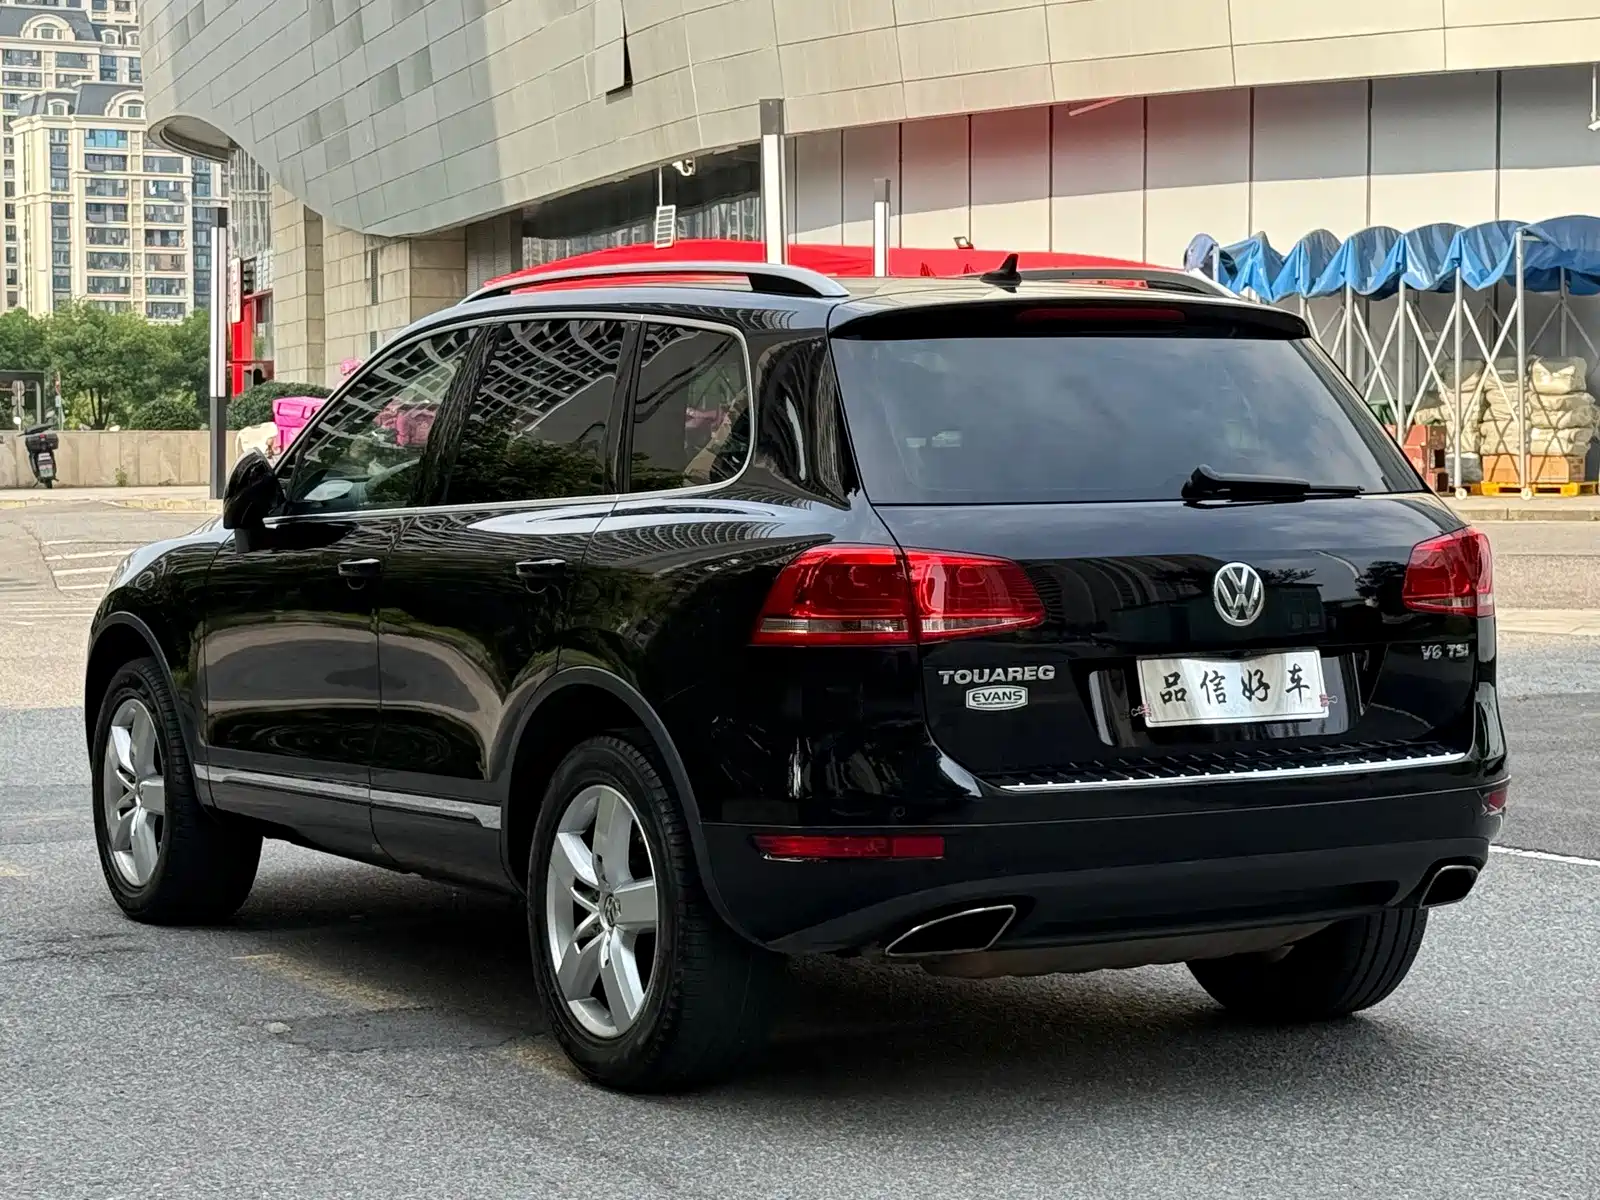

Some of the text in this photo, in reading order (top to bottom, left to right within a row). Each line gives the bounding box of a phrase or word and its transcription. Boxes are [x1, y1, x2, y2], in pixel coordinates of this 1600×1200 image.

[1421, 644, 1442, 660] V6
[938, 665, 1056, 685] TOUAREG
[1159, 663, 1311, 705] 品信好车
[971, 690, 1023, 703] EVANS
